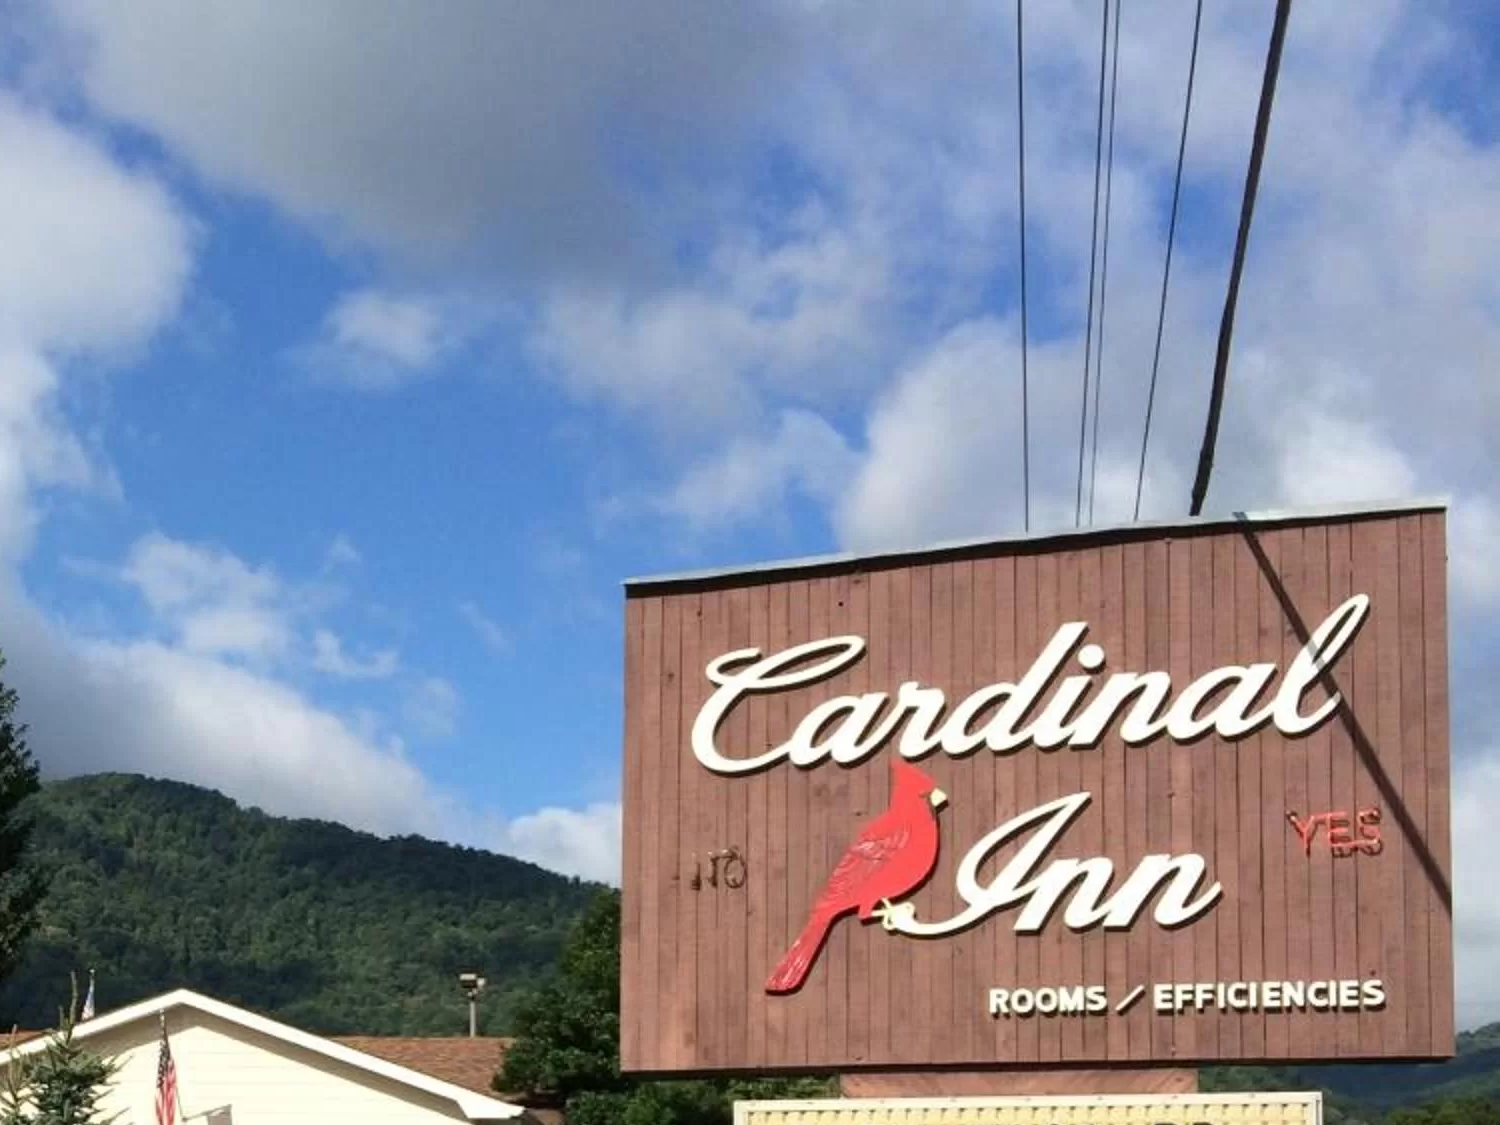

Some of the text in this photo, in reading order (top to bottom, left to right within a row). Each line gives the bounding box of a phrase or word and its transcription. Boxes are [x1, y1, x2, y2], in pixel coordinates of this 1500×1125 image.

[691, 594, 1371, 775] Cardinal
[900, 791, 1223, 937] Inn
[1284, 807, 1383, 858] YES
[989, 985, 1108, 1014] ROOMS
[1153, 979, 1386, 1011] EFFICIENCIES
